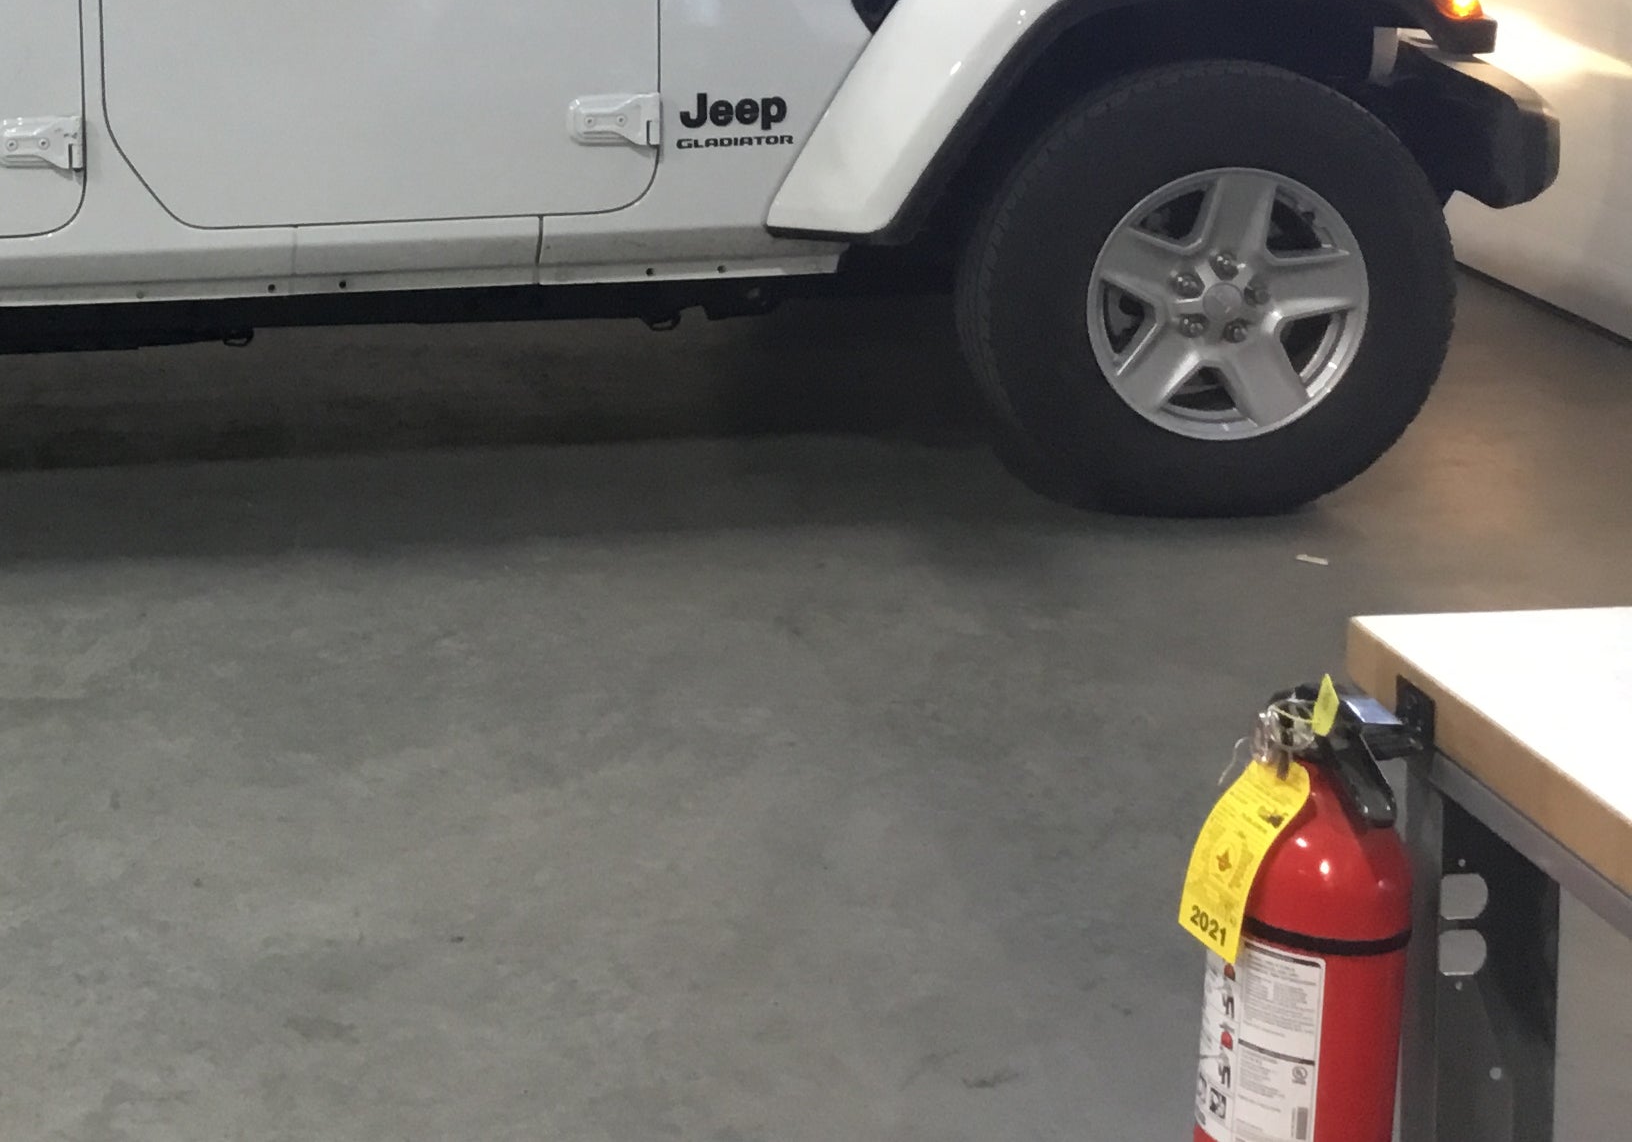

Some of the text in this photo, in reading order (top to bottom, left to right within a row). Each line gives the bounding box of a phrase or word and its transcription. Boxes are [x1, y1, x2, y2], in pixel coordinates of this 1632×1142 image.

[679, 92, 788, 130] Jeep
[676, 134, 794, 149] GLADIATOR
[1190, 904, 1227, 947] 2021
